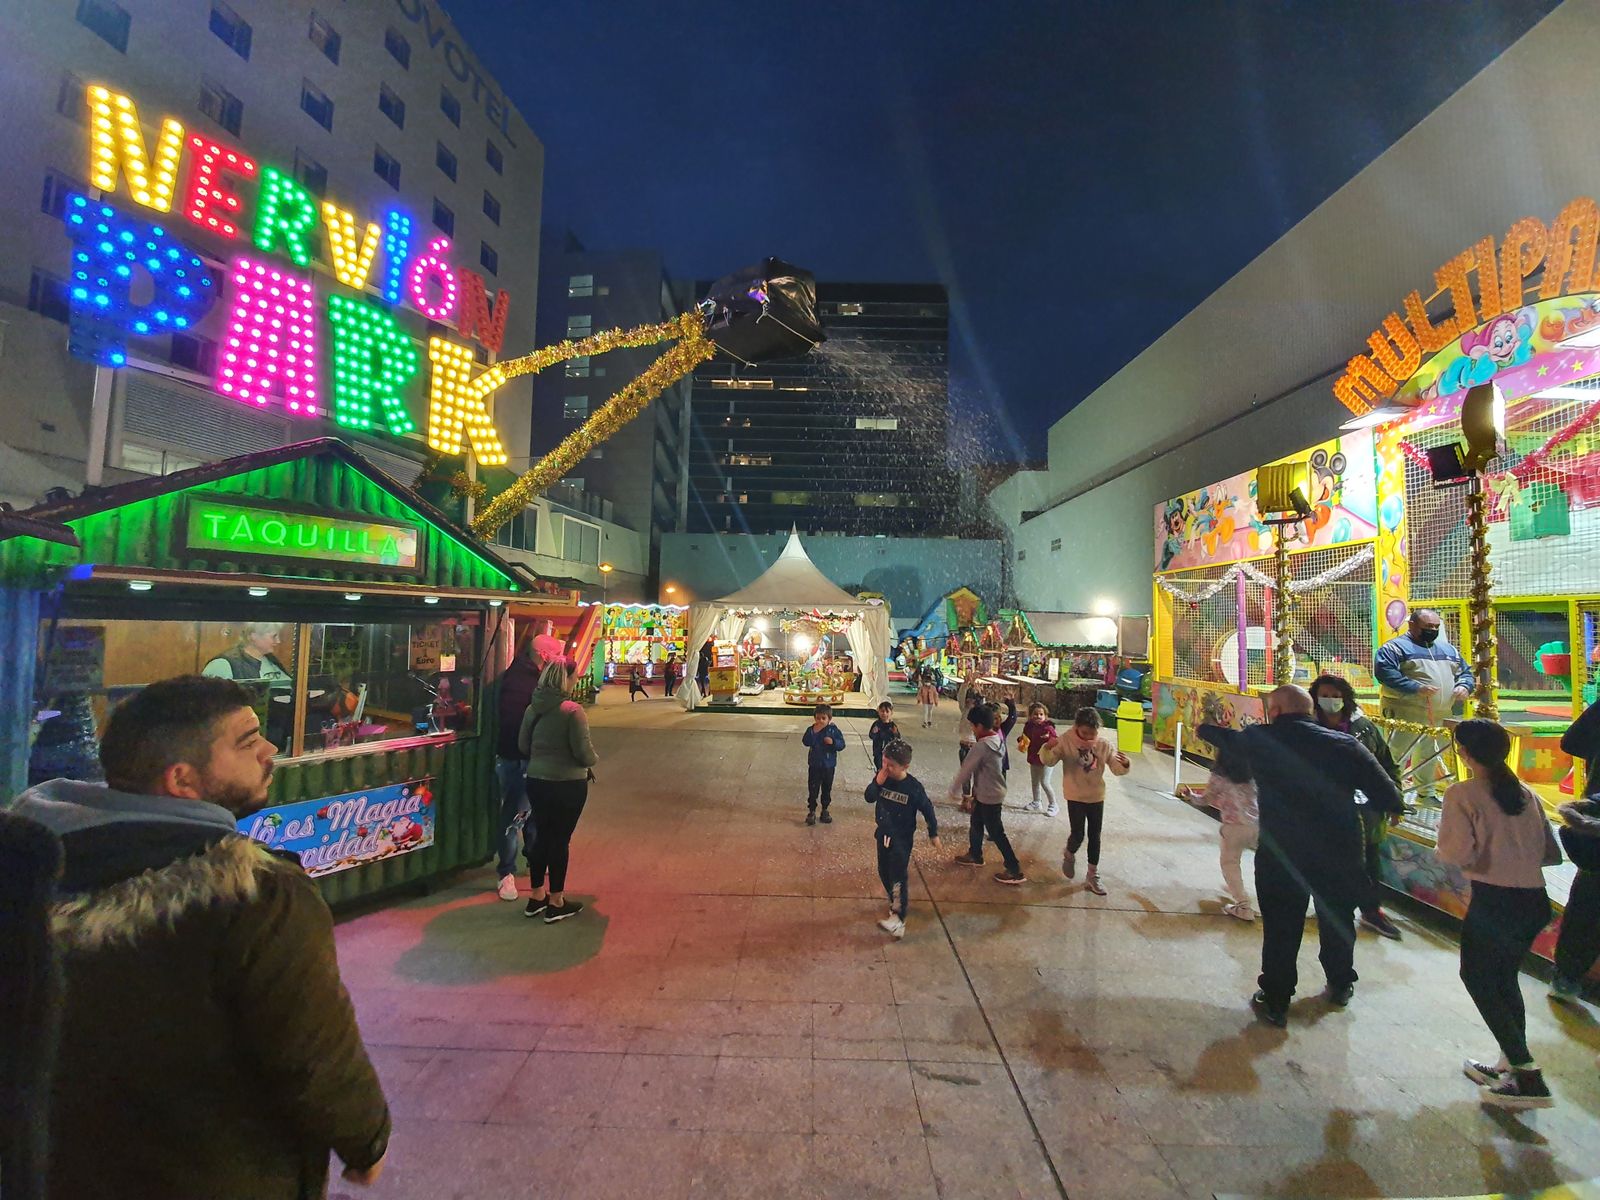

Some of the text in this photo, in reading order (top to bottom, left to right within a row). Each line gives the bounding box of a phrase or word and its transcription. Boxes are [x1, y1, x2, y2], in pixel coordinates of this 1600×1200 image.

[87, 84, 509, 352] NERVIÓN
[65, 192, 507, 466] PARK
[1332, 195, 1600, 417] MULTIPA
[204, 514, 398, 557] TAQUILLA
[412, 640, 439, 648] TICKET
[280, 814, 314, 842] es
[327, 788, 422, 832] Magia
